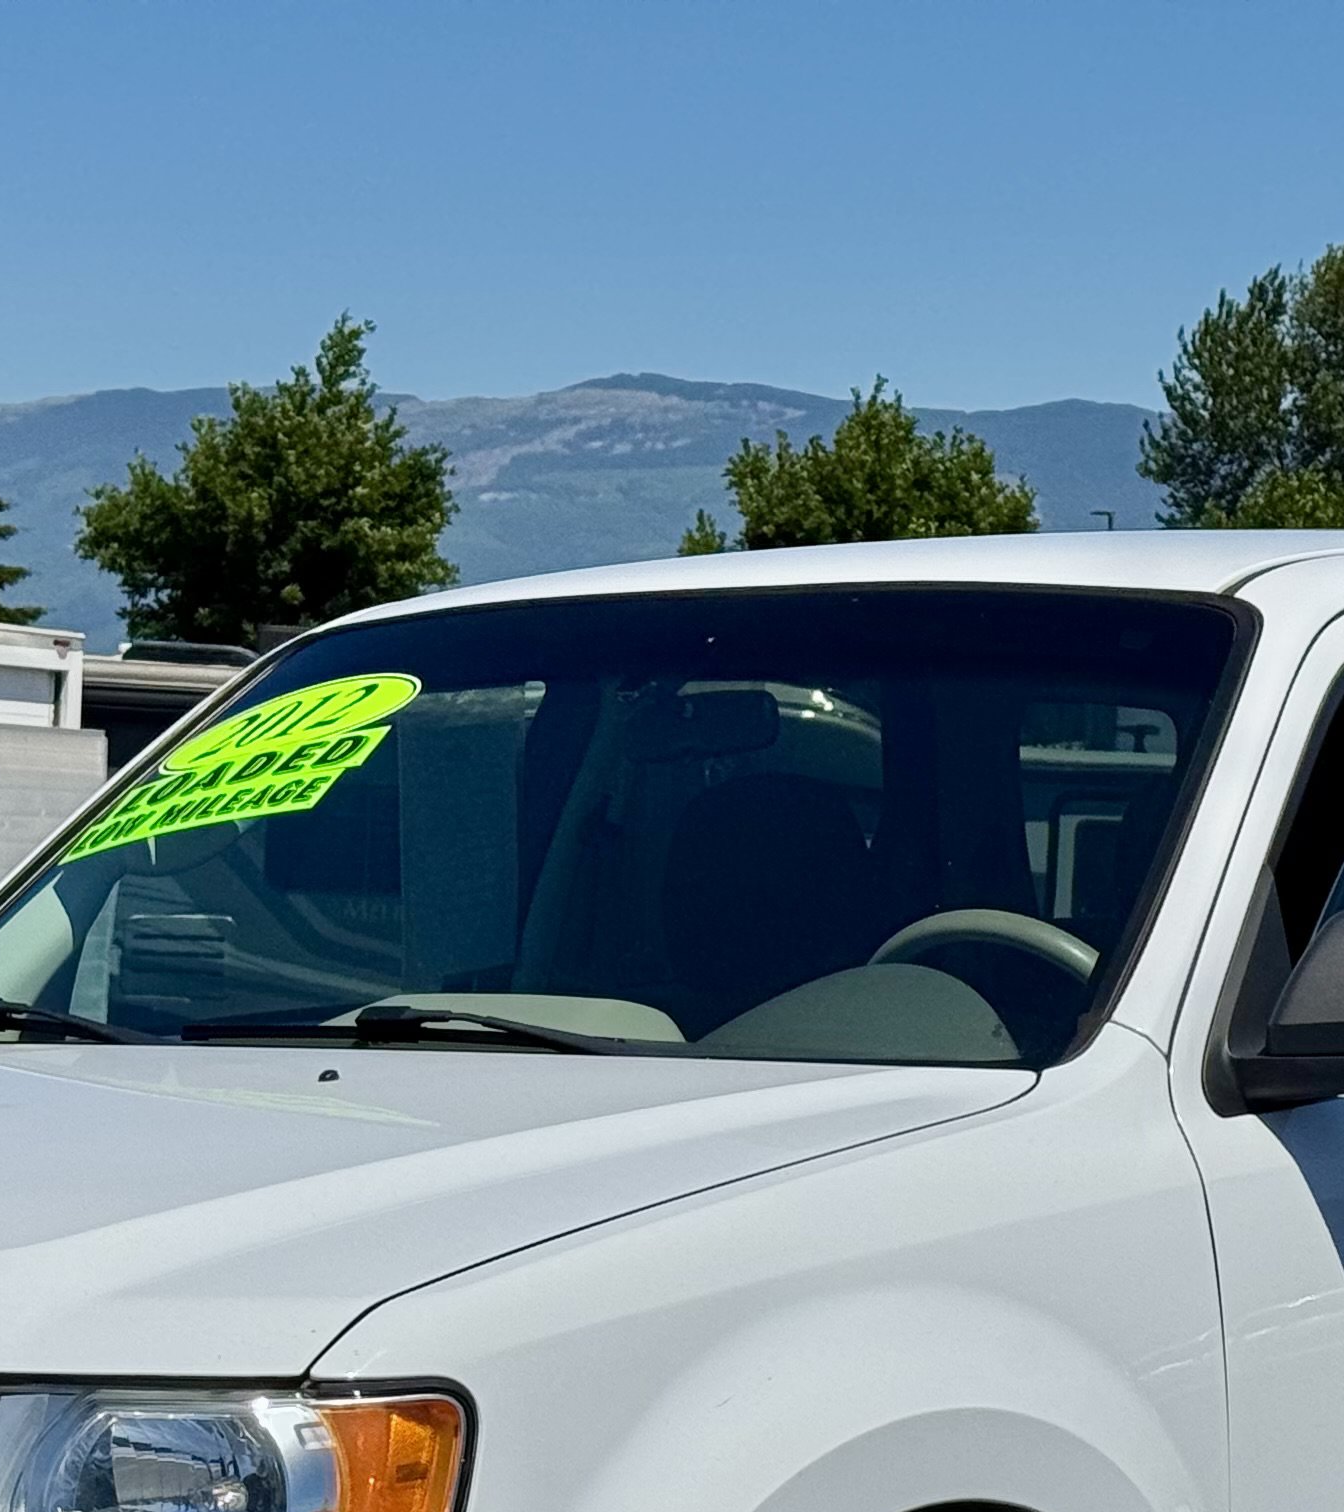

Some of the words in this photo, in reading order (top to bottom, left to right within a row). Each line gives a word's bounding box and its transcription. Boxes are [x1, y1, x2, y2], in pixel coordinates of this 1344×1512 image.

[188, 683, 379, 763] 2012
[68, 810, 155, 856] LOW
[150, 774, 331, 830] MILEAGE
[113, 735, 370, 818] LOADED
